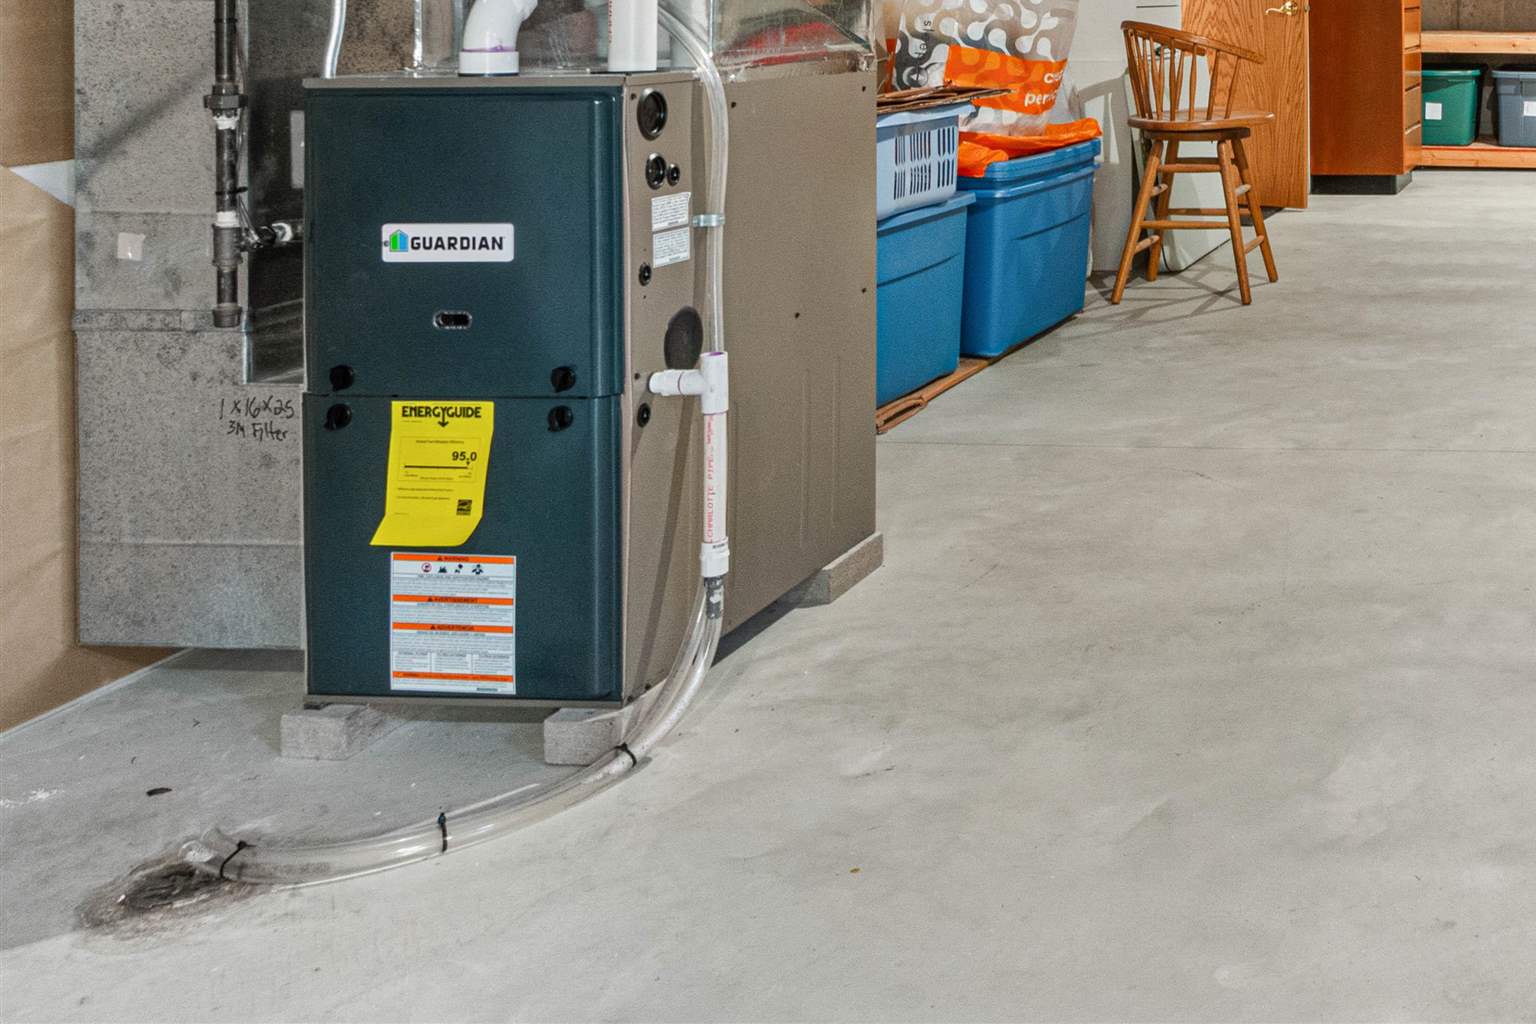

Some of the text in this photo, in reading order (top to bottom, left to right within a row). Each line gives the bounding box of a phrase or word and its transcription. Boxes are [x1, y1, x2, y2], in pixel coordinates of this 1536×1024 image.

[410, 236, 503, 251] GUARDIAN
[401, 405, 482, 419] ENERGYGUIDE
[251, 420, 289, 443] Filter
[451, 451, 478, 462] 95.0
